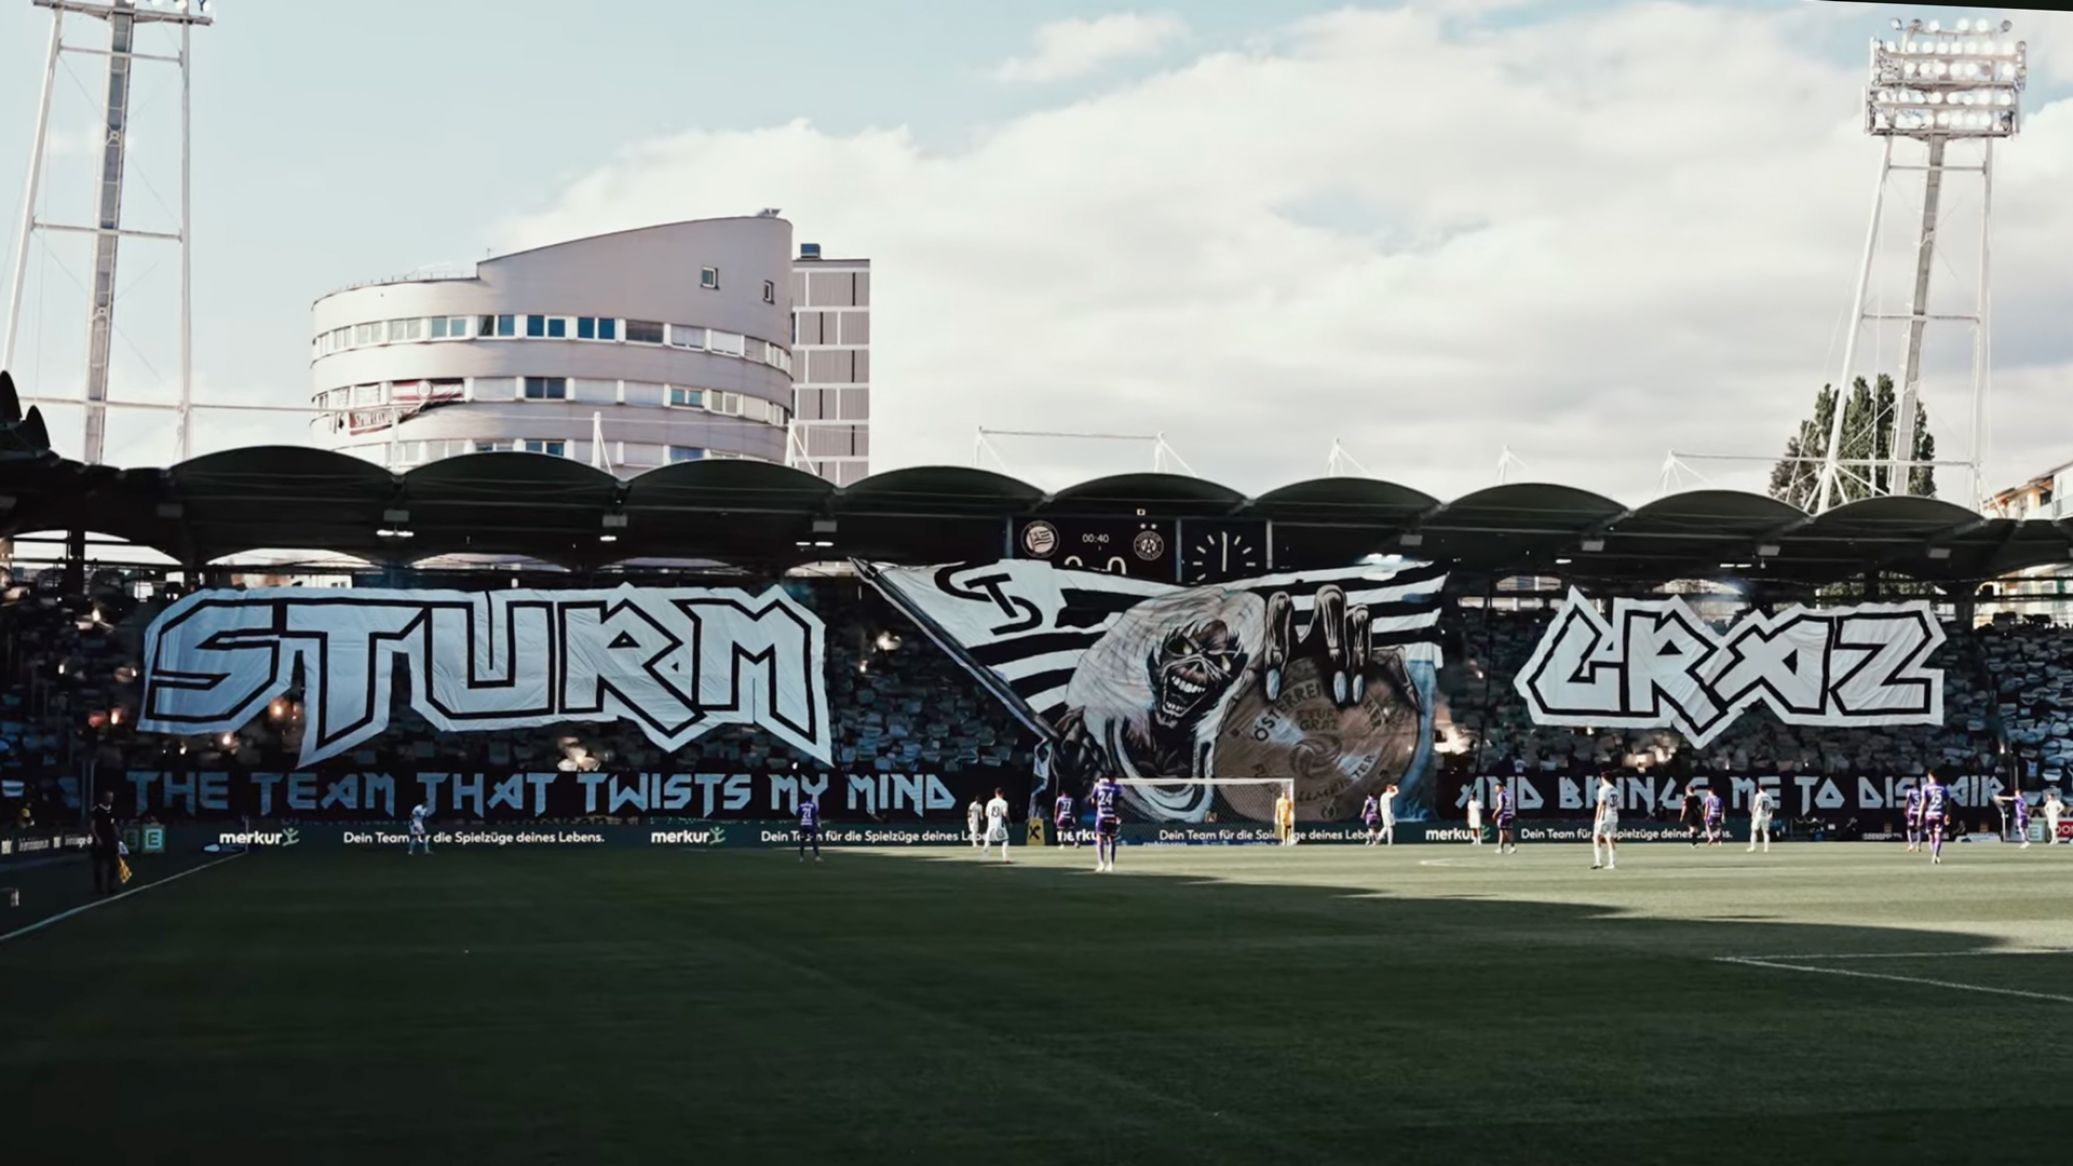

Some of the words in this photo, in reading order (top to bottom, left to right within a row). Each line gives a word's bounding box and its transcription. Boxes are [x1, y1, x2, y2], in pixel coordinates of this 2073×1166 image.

[1082, 533, 1109, 543] 00:40
[145, 597, 817, 749] STURM
[1527, 603, 1932, 735] GRAZ
[126, 771, 229, 817] THE
[250, 772, 395, 817] TEAM
[416, 772, 558, 818] THAT
[577, 773, 752, 818] TWISTS
[768, 774, 828, 817] MY
[847, 774, 957, 818] MIND
[1099, 791, 1113, 805] 24
[1455, 776, 1544, 816] AND
[1729, 776, 1781, 812] ME
[1794, 776, 1845, 816] TO
[219, 829, 283, 844] merkur
[343, 831, 372, 843] Dein
[375, 831, 410, 843] Team
[433, 831, 452, 843] die
[455, 830, 513, 847] Spielzüge
[516, 830, 556, 843] deines
[558, 831, 605, 843] Lebens.
[651, 829, 710, 843] merkur
[761, 830, 788, 842] Dein
[825, 830, 842, 842] für
[844, 830, 862, 842] die
[864, 830, 918, 846] Spielzüge
[922, 830, 958, 842] deines
[1159, 829, 1184, 841] Dein
[1186, 829, 1216, 841] Team
[1218, 829, 1237, 841] für
[1238, 829, 1254, 841] die
[1308, 829, 1343, 840] deines
[1521, 828, 1545, 839] Dein
[1547, 828, 1575, 839] Team
[1576, 828, 1592, 839] für
